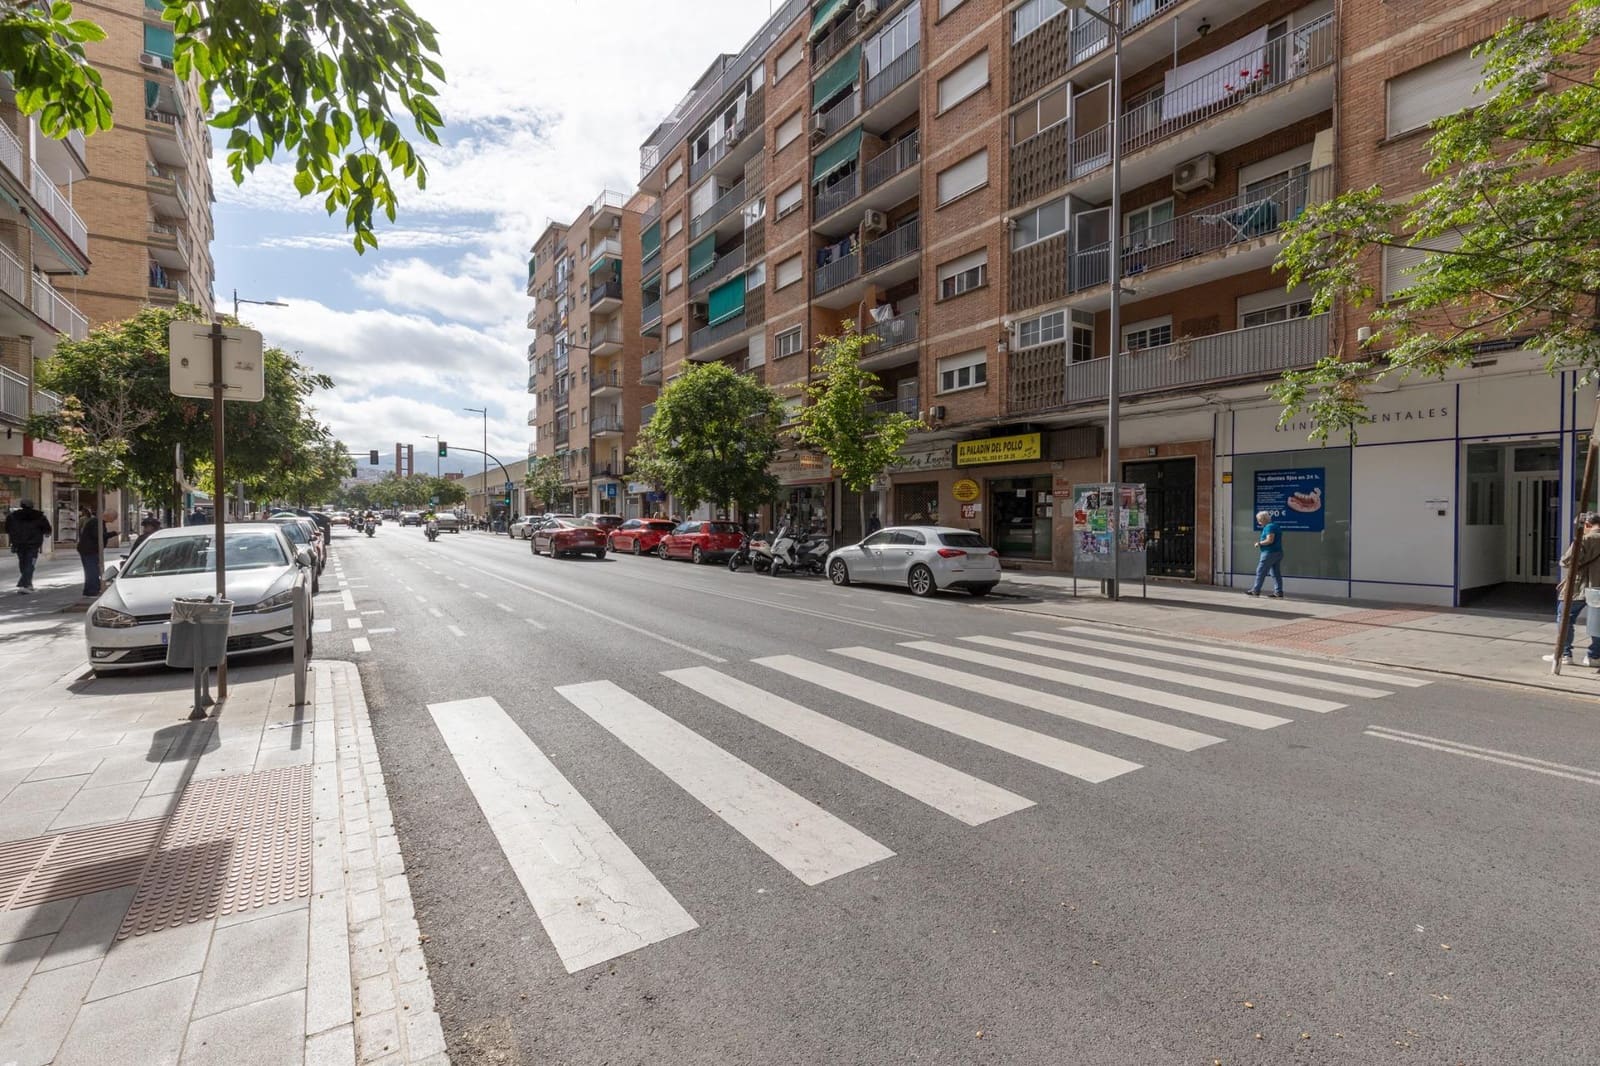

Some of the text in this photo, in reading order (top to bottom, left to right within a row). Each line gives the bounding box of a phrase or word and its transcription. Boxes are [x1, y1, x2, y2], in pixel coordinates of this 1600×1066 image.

[1362, 407, 1448, 424] ENTALES
[991, 442, 1002, 453] DEL
[1003, 440, 1023, 452] POLLO
[1286, 474, 1297, 482] fijos
